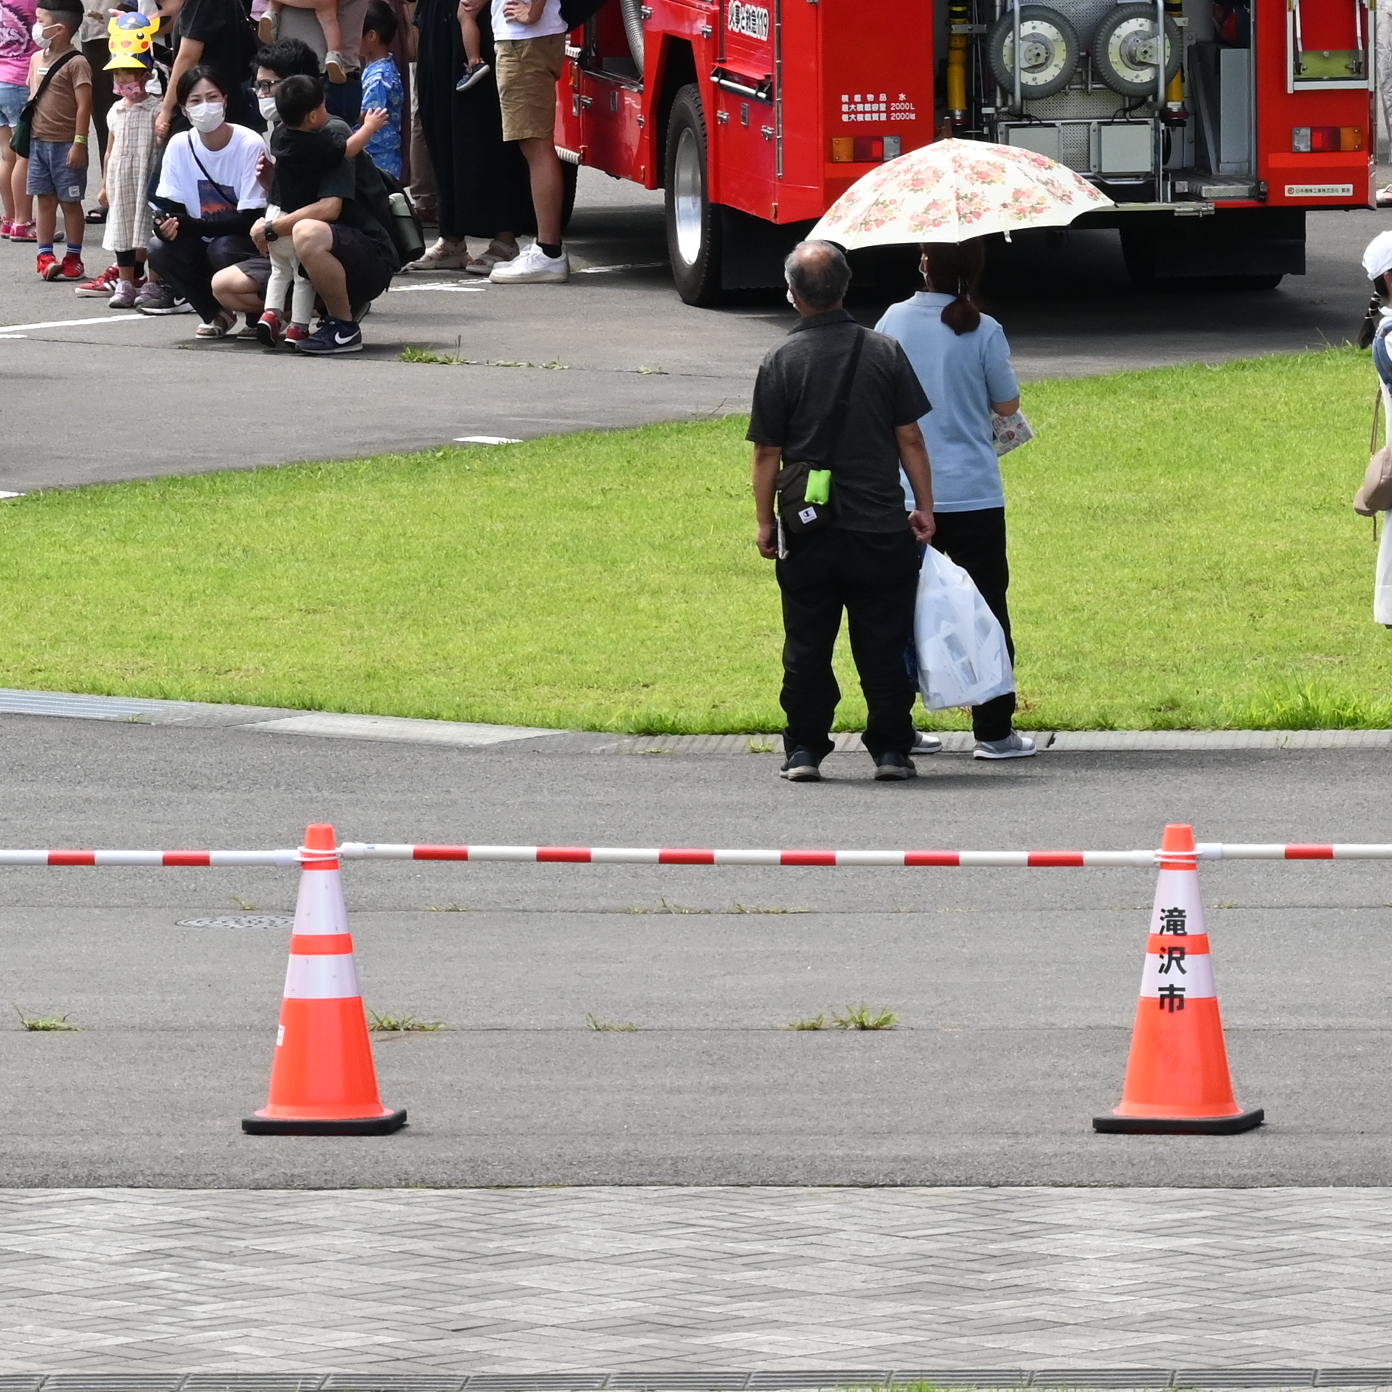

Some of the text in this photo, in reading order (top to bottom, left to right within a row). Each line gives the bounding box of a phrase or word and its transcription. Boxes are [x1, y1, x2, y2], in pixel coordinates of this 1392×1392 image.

[898, 93, 906, 101] 水
[890, 103, 915, 111] 2000L
[1158, 907, 1188, 1013] 滝沢市
